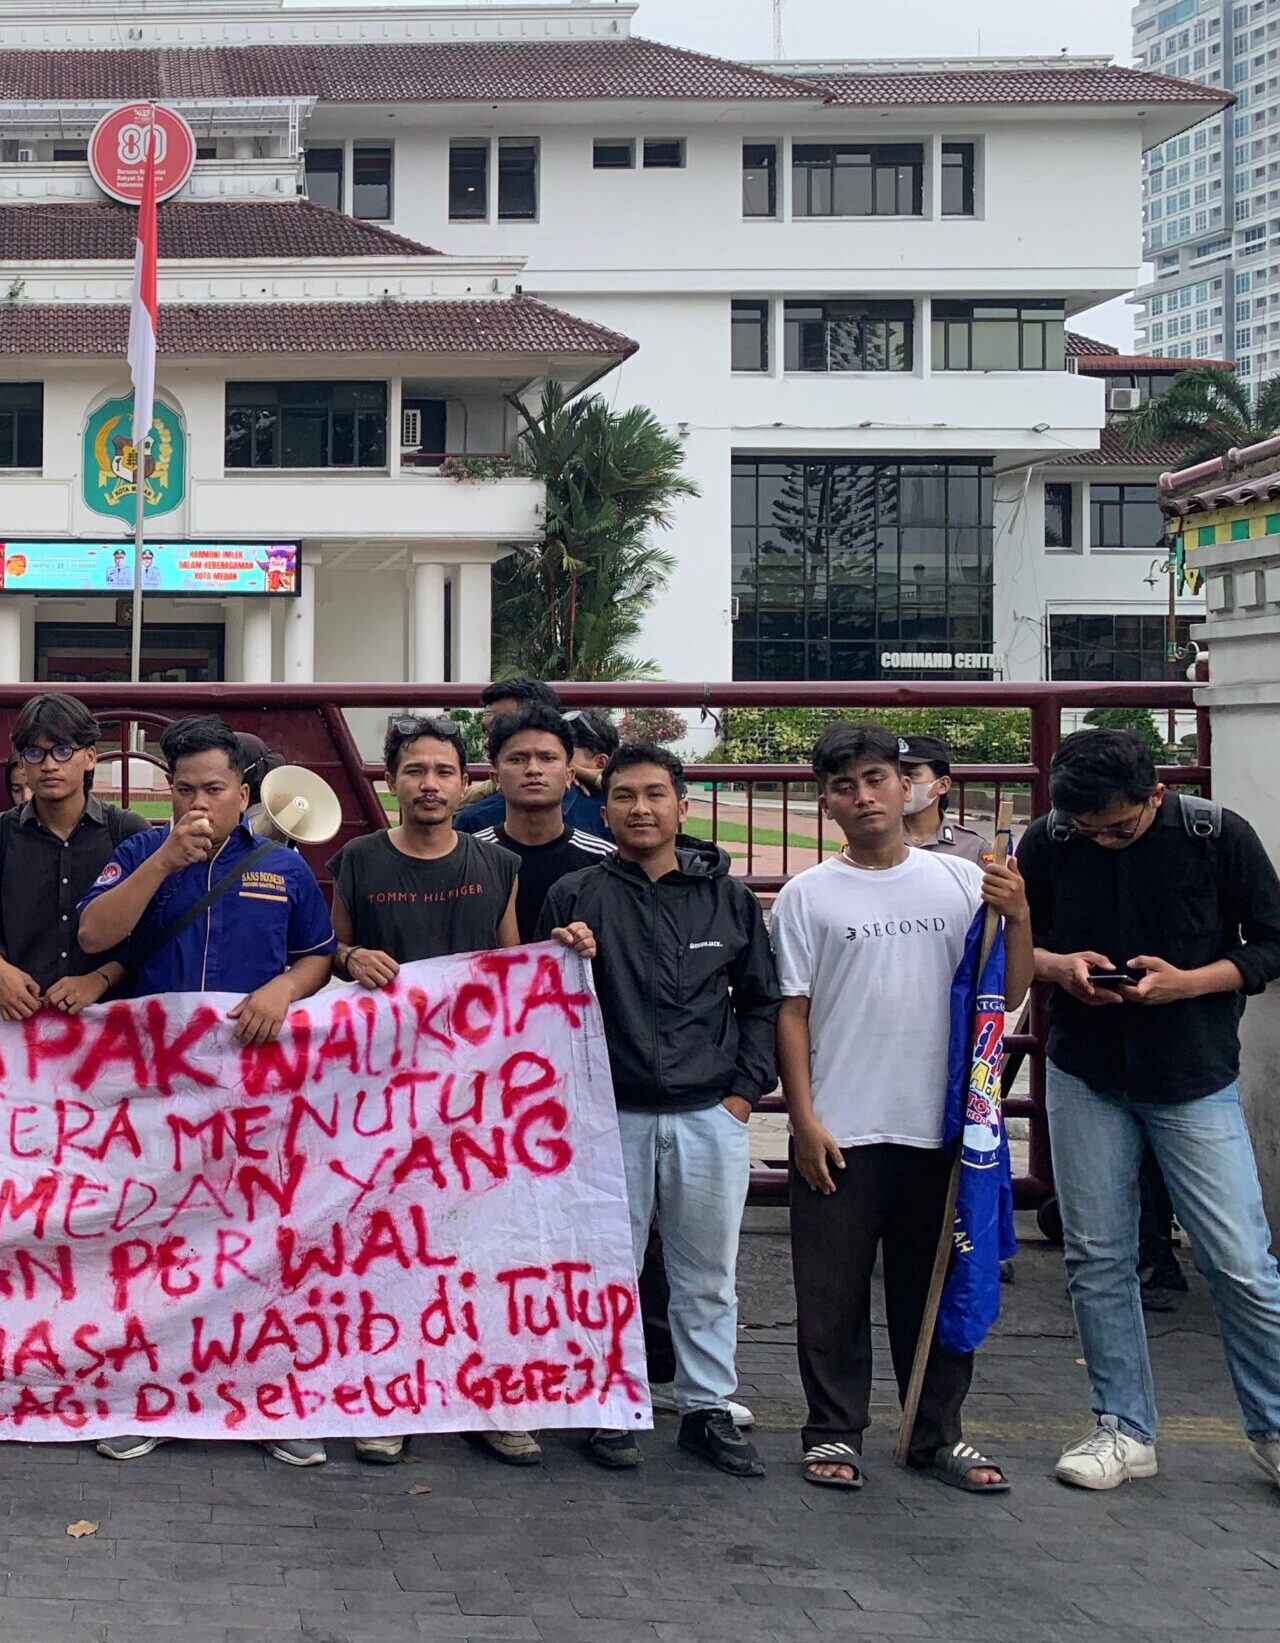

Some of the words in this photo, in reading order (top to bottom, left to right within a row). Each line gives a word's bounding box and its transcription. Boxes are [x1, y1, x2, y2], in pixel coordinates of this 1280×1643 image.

[118, 124, 167, 165] 80
[189, 550, 220, 559] HARMONI
[178, 561, 202, 569] DALAM
[194, 572, 211, 580] KOTA
[213, 572, 238, 581] MEDAN
[881, 652, 952, 668] COMMAND
[368, 892, 416, 904] TOMMY
[423, 884, 484, 903] HILFIGER
[862, 917, 946, 938] SECOND
[166, 1051, 557, 1171] MENUTUP
[328, 1096, 575, 1213] YANG
